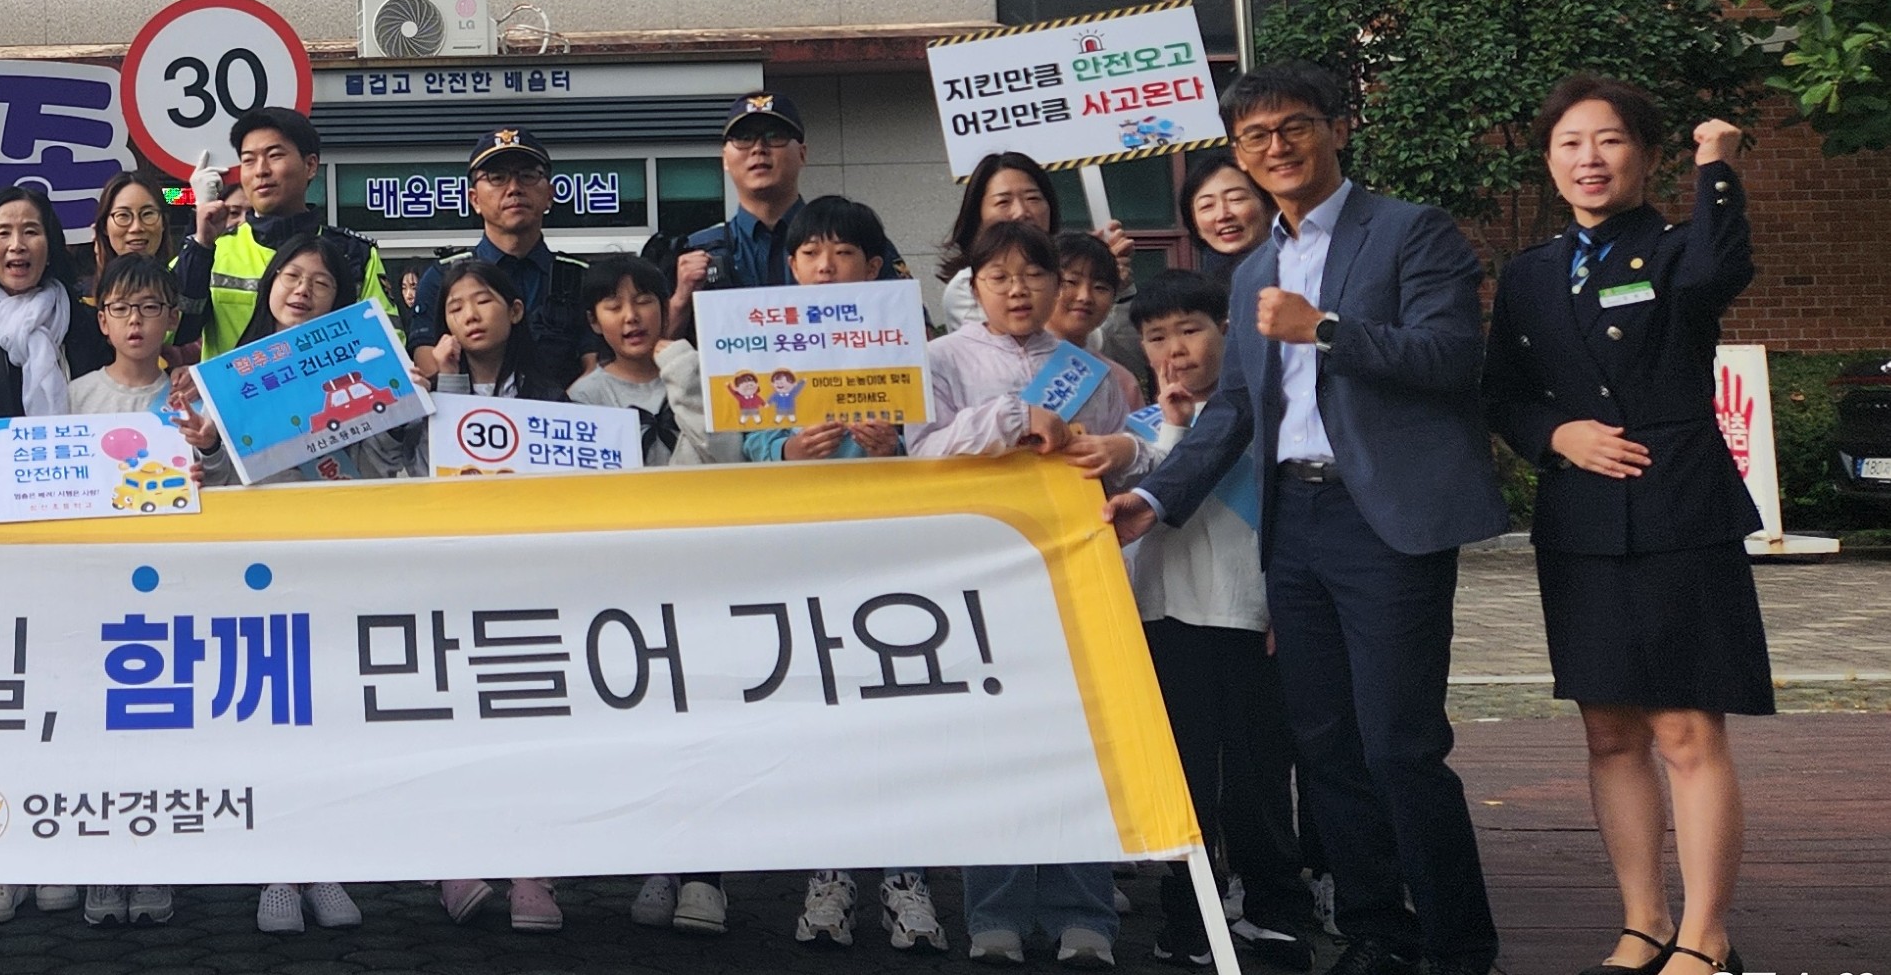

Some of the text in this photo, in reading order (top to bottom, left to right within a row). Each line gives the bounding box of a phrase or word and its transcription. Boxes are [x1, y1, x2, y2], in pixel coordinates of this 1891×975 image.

[458, 20, 475, 30] LG
[425, 71, 492, 93] 안전한
[504, 70, 571, 93] 배움터
[943, 42, 1196, 102] 지킨만큼 안전오고
[163, 47, 268, 129] 30
[952, 76, 1205, 136] 어긴만큼 사고온다
[366, 175, 469, 218] 배움터
[749, 304, 864, 326] 속도를 줄이면,
[715, 329, 909, 354] 아이의 웃음이 커집니다.
[240, 381, 259, 400] 손
[261, 367, 297, 391] 들고
[12, 426, 47, 441] 차를
[466, 422, 508, 449] 30
[527, 416, 598, 443] 학교앞
[13, 446, 47, 462] 손을
[528, 443, 622, 469] 안전운행
[14, 465, 89, 483] 안전하게
[101, 612, 313, 731] 함께
[357, 601, 689, 723] 만들어
[730, 590, 1004, 705] 가요!
[23, 786, 254, 839] 양산경찰서
